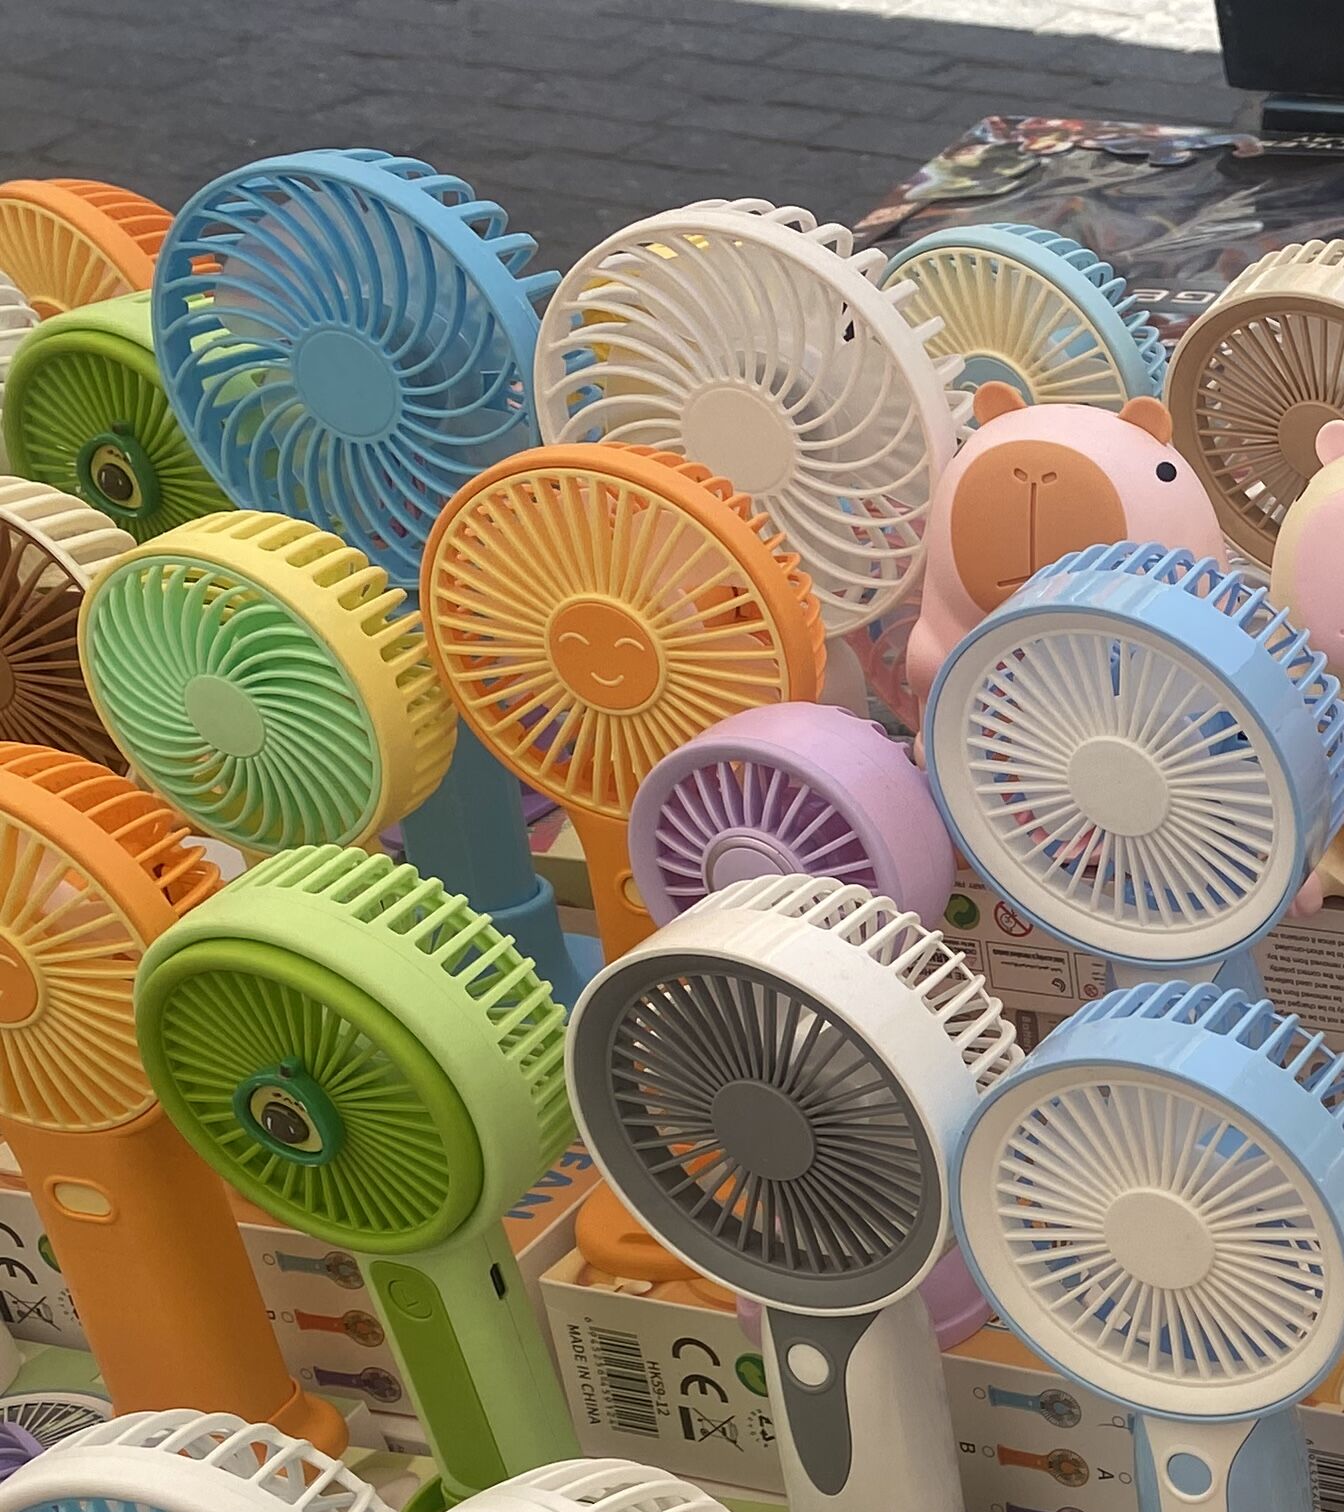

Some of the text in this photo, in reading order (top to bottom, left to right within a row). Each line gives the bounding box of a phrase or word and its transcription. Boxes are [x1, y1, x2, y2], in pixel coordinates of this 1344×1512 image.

[565, 1323, 602, 1425] MADE IN CHINA
[646, 1360, 670, 1416] HK59-12
